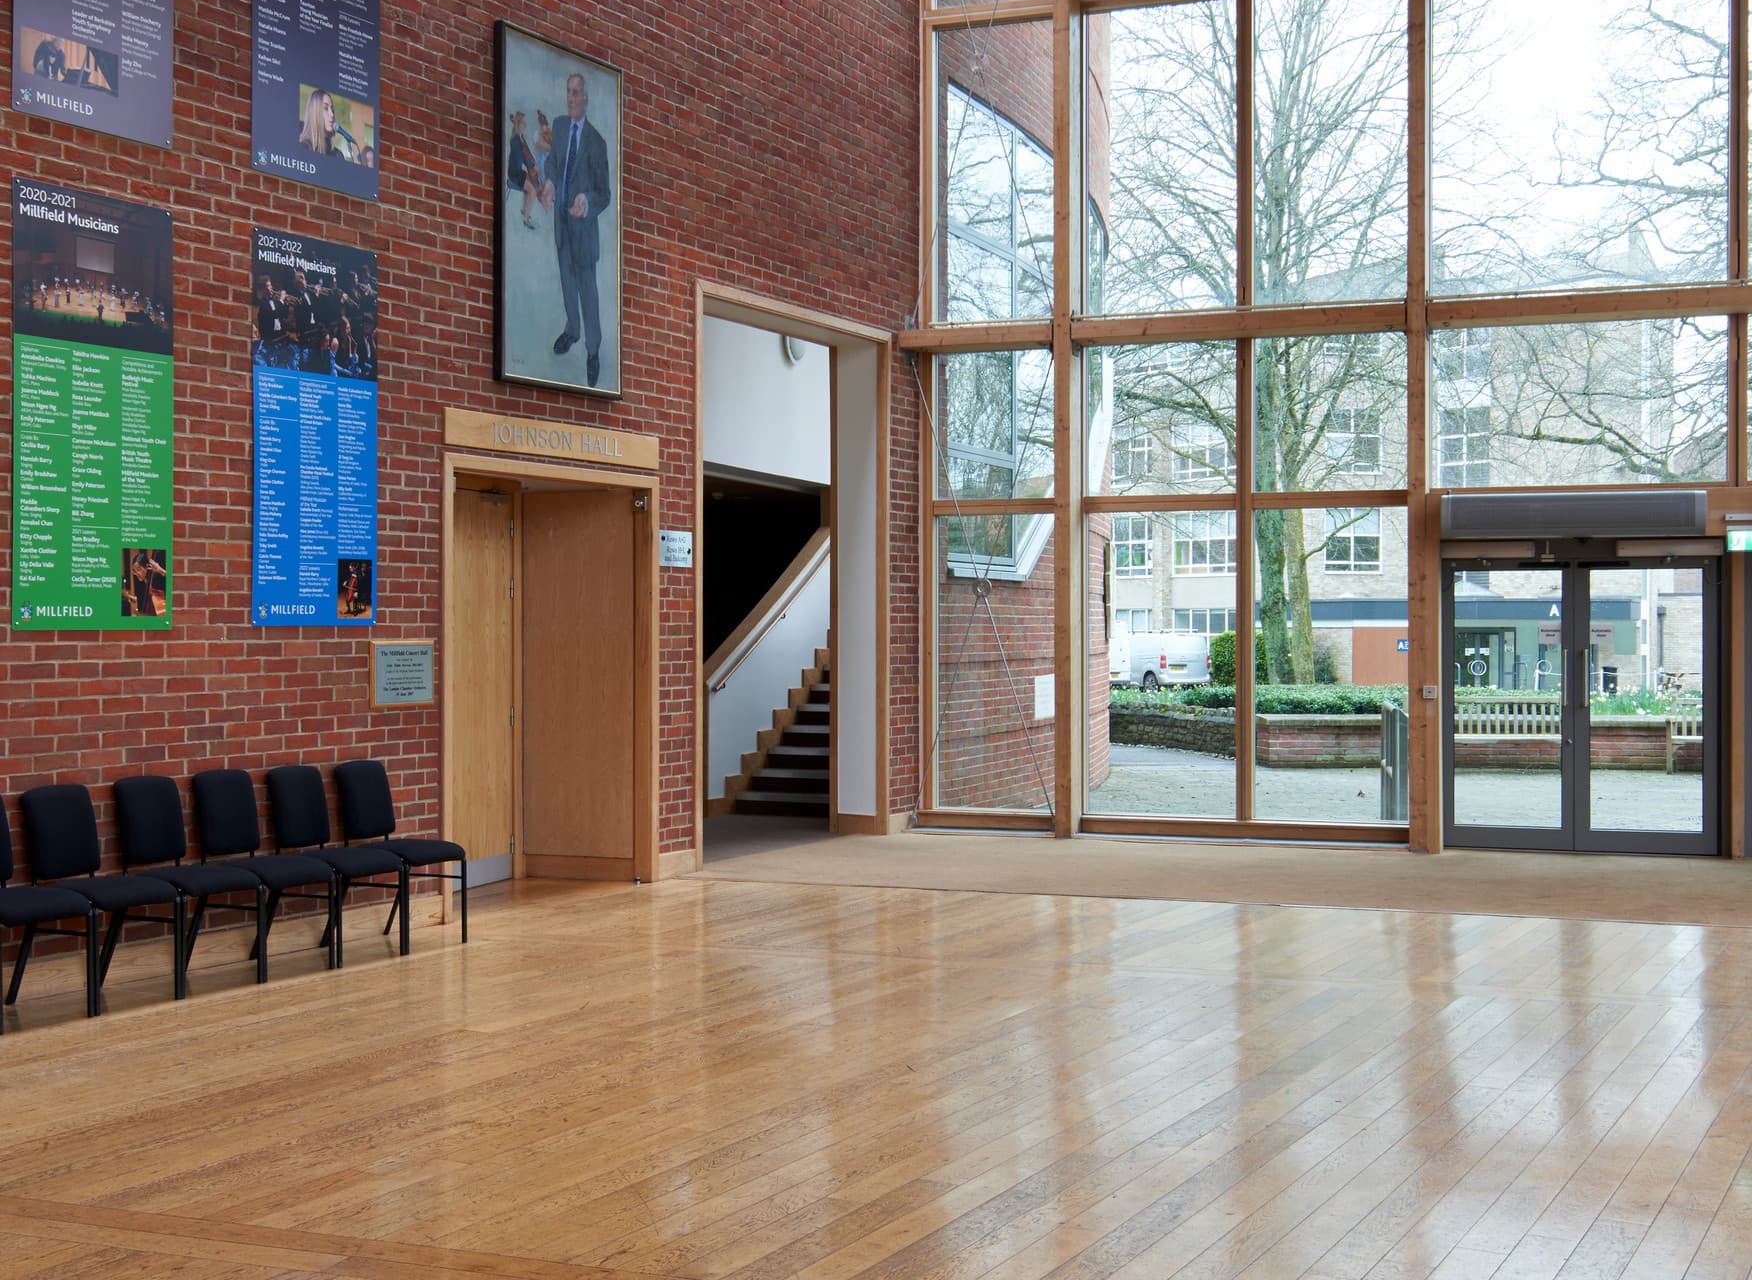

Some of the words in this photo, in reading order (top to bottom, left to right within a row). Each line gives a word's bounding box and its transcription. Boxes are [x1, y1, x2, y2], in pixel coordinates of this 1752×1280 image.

[36, 90, 92, 116] MILLFIELD
[270, 153, 315, 174] MILLFIELD
[19, 186, 76, 209] 2020-2021
[19, 204, 63, 224] Millfield
[68, 213, 119, 235] Musicians
[258, 233, 301, 254] 2021-2022
[258, 248, 294, 267] Millfield
[296, 256, 336, 276] Musicians
[493, 422, 572, 451] JOHNSON
[581, 433, 622, 457] HALL
[36, 606, 92, 616] MILLFIELD
[271, 604, 315, 614] MILLFIELD
[1549, 604, 1560, 616] A
